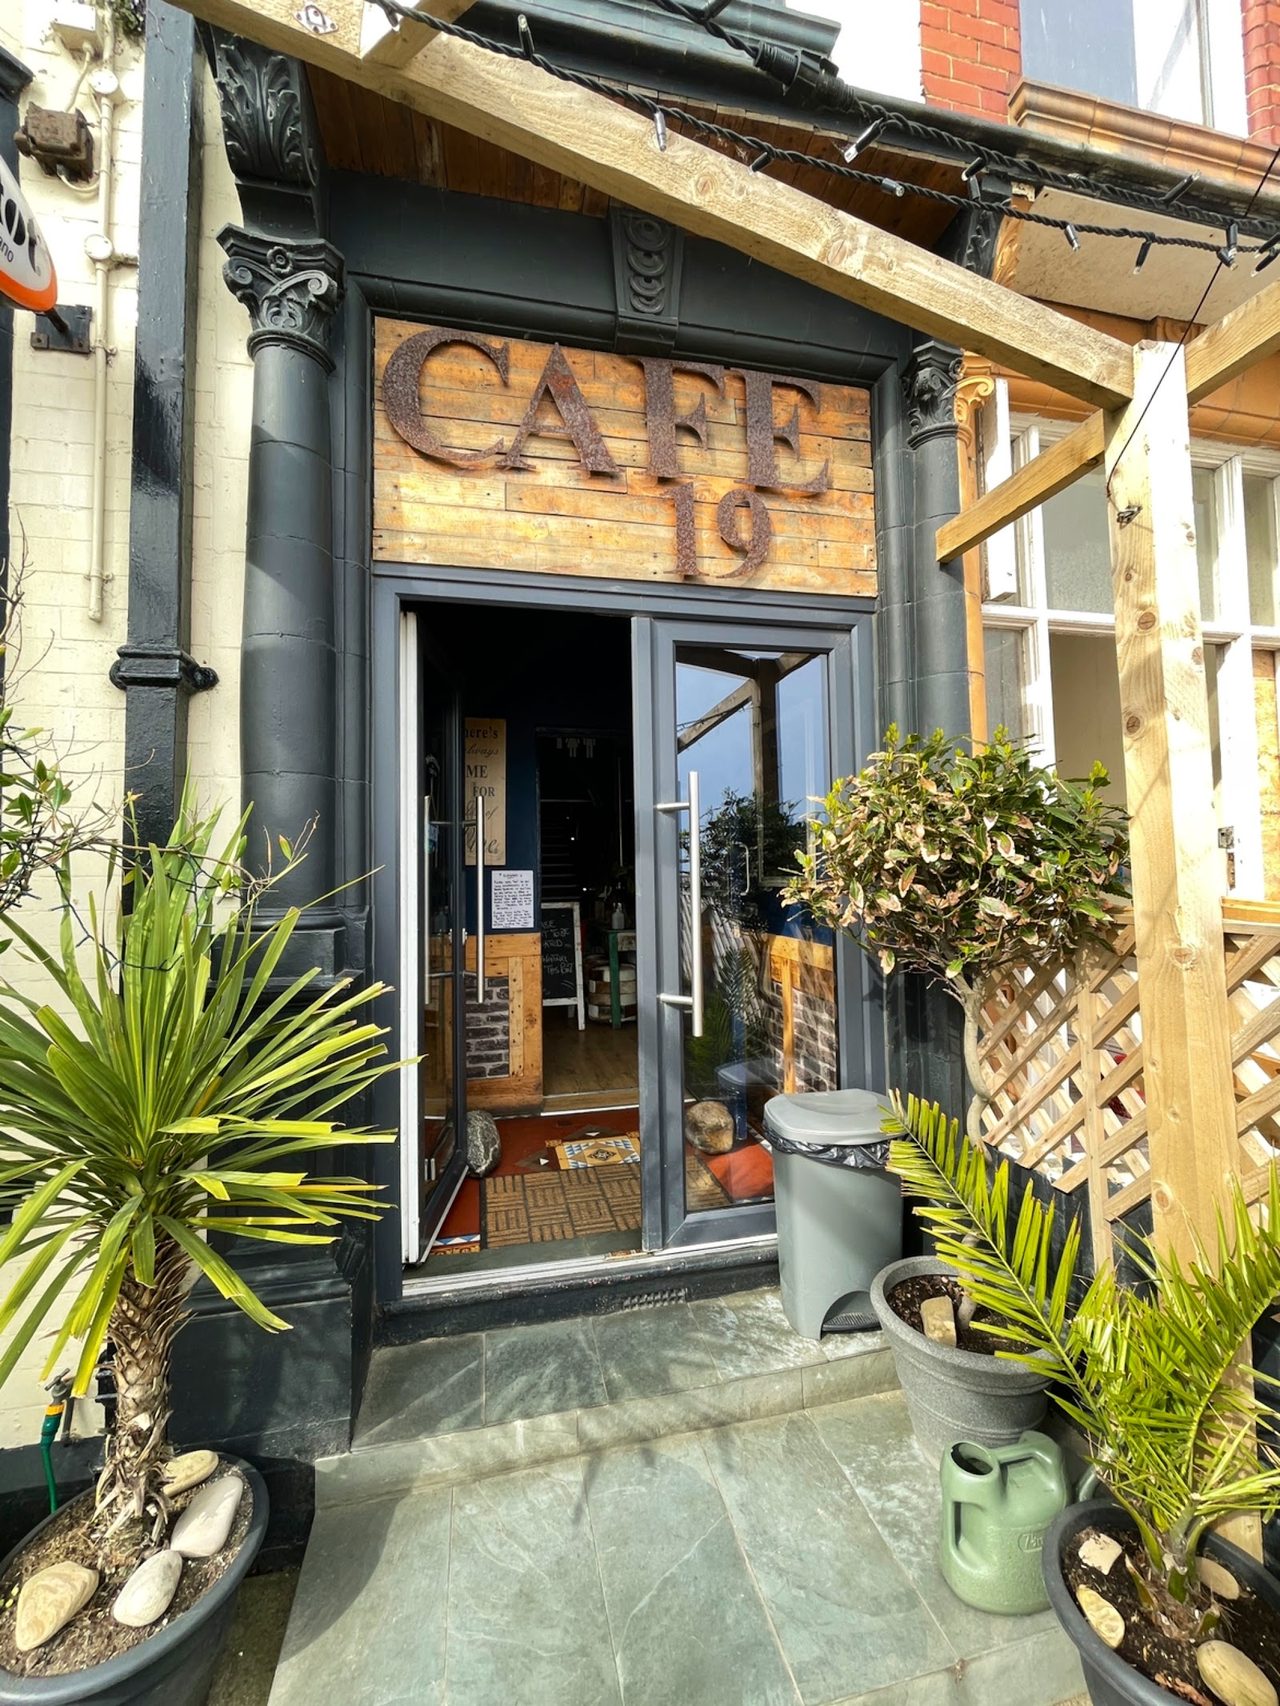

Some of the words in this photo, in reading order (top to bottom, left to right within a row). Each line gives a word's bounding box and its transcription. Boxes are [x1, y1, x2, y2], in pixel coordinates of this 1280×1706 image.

[382, 327, 829, 494] CAFE
[665, 481, 771, 579] 19
[472, 786, 496, 797] FOR
